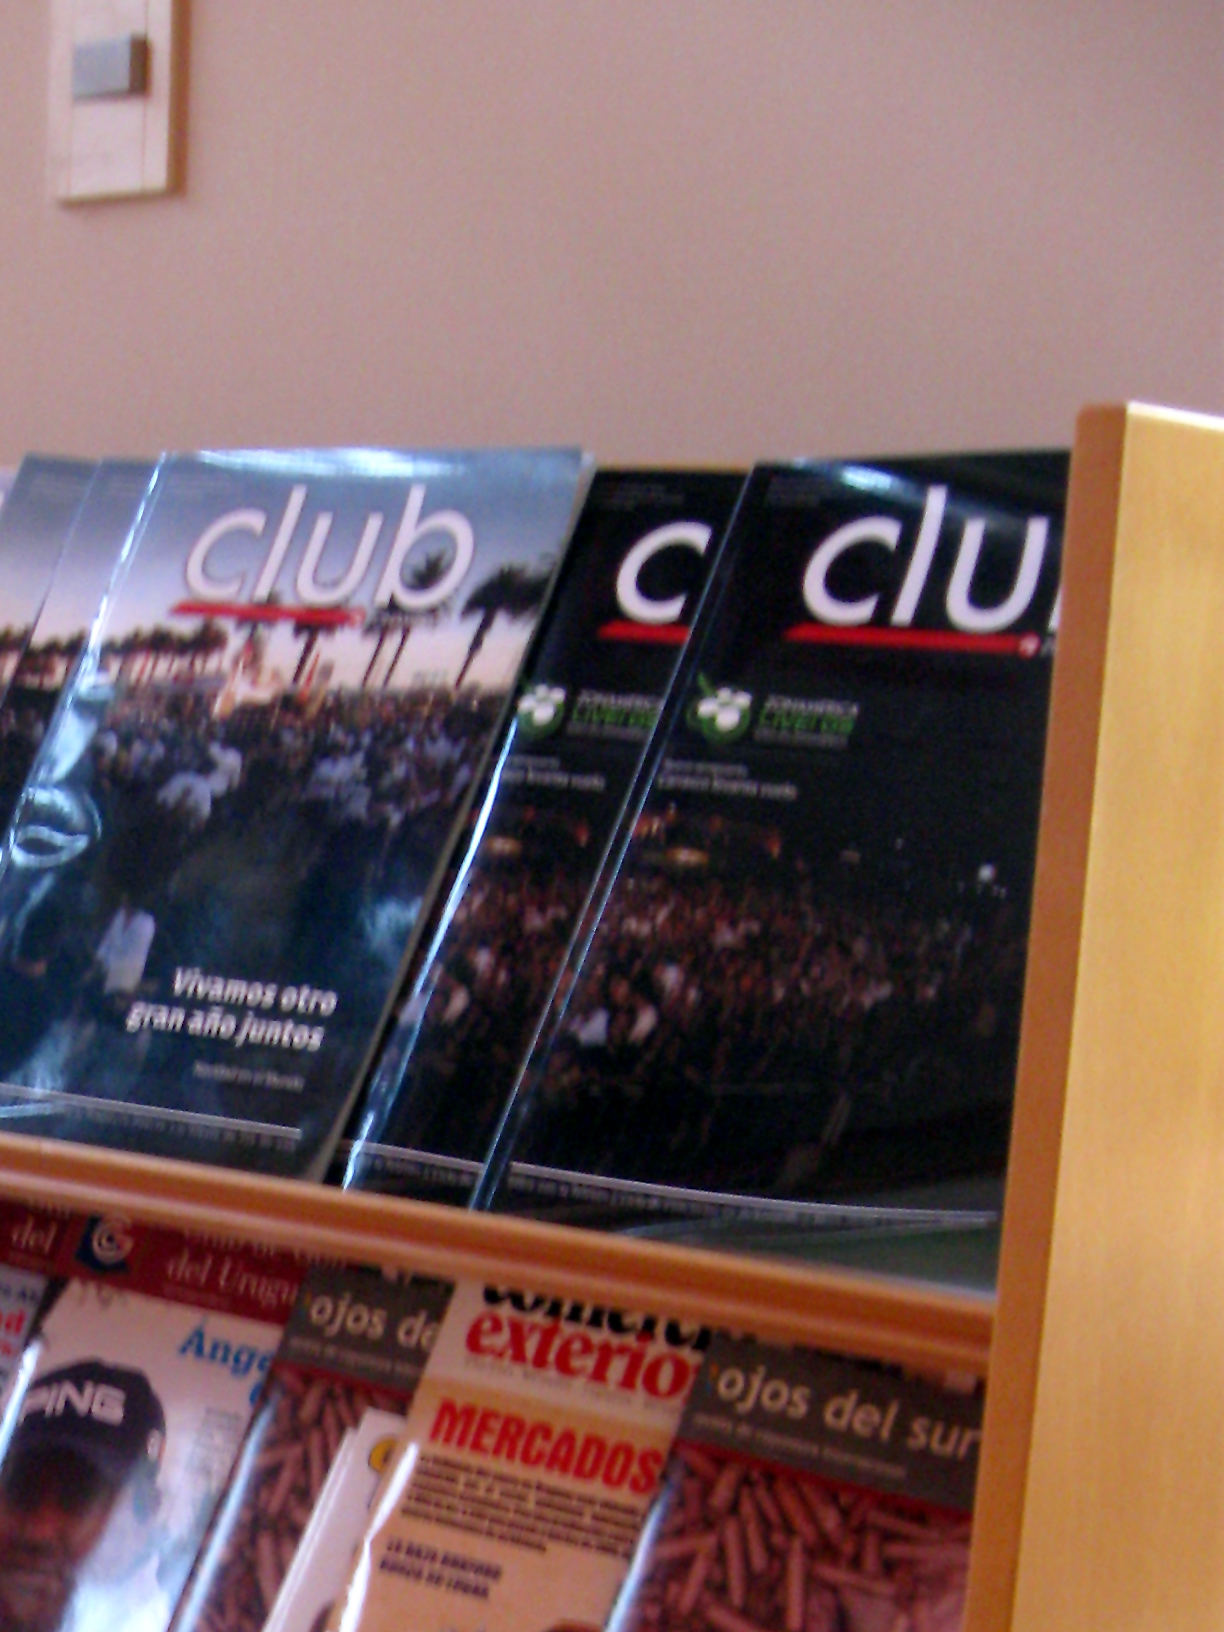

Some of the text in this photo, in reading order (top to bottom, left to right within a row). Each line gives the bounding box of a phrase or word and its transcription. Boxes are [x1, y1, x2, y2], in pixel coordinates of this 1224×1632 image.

[185, 484, 475, 611] club
[802, 484, 1062, 634] clu
[126, 1000, 325, 1052] gran año juntos
[173, 966, 339, 1017] Vivamos otro
[310, 1292, 387, 1342] ojos
[466, 1308, 699, 1402] exterio
[429, 1397, 665, 1496] MERCADOS
[717, 1364, 810, 1421] ojos
[824, 1388, 899, 1444] del
